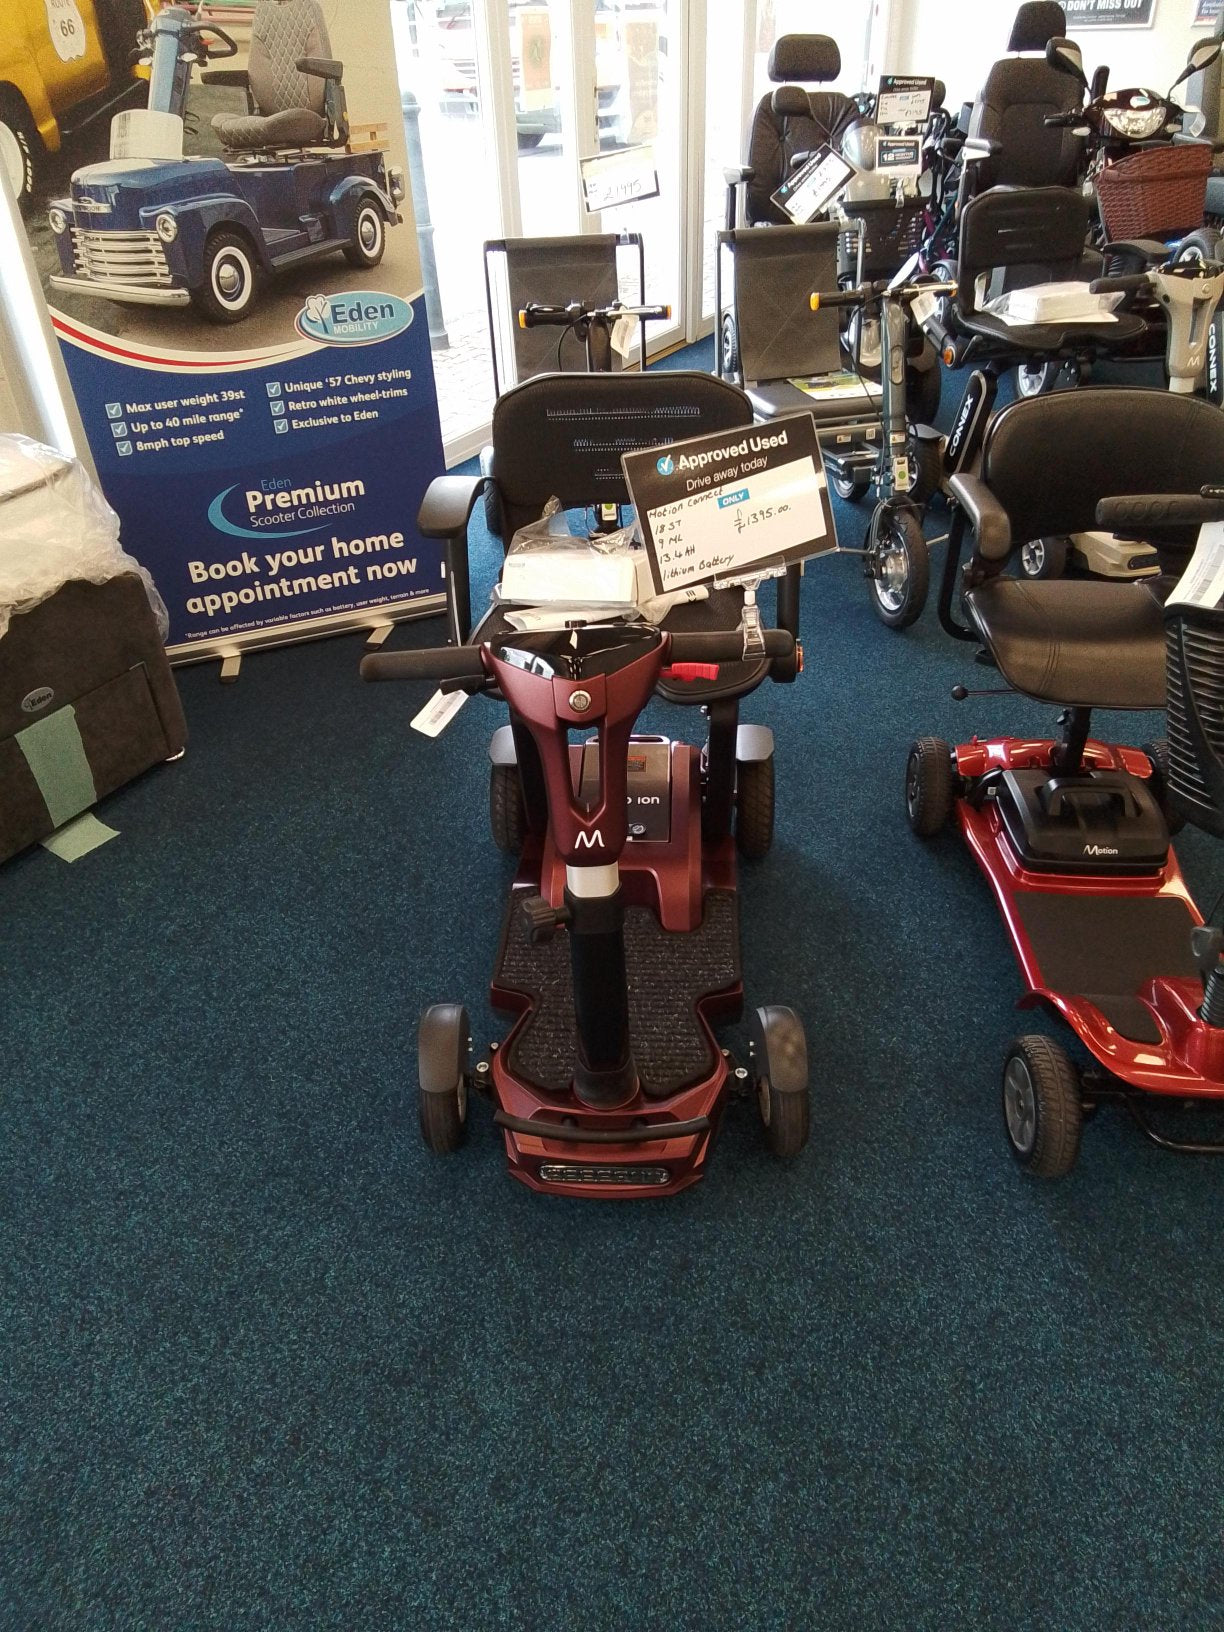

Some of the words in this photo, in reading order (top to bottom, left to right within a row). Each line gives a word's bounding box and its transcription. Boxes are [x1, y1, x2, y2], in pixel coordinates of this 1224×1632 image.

[61, 18, 75, 37] 66
[330, 301, 395, 325] Eden
[285, 379, 323, 393] Unique
[344, 373, 375, 386] Chevy
[377, 369, 412, 382] styling
[126, 402, 152, 414] Max
[154, 400, 178, 410] user
[180, 393, 219, 407] weight
[220, 389, 246, 401] 39st
[288, 399, 317, 411] Retro
[319, 394, 348, 407] white
[350, 387, 408, 403] wheel-trims
[131, 422, 149, 434] Up
[151, 420, 163, 430] to
[165, 417, 180, 428] 40
[182, 414, 206, 426] mile
[292, 415, 339, 429] Exclusive
[340, 412, 352, 423] to
[353, 410, 379, 422] Eden
[949, 393, 974, 457] CONNEX
[136, 438, 169, 452] 8mph
[171, 435, 191, 447] top
[192, 430, 225, 445] speed
[678, 440, 749, 470] Approved
[749, 430, 788, 452] Used
[261, 477, 292, 491] Eden
[686, 475, 711, 492] Drive
[713, 465, 739, 482] away
[741, 455, 768, 473] today
[245, 479, 366, 513] Premium
[722, 491, 745, 506] ONLY
[250, 511, 296, 528] Scooter
[297, 502, 355, 520] Collection
[648, 503, 683, 518] Motion
[655, 524, 665, 535] 18
[658, 538, 664, 549] 9
[187, 552, 260, 584] Book
[265, 544, 326, 576] your
[331, 531, 405, 559] home
[699, 554, 735, 570] Battery
[186, 567, 361, 617] appointment
[366, 558, 418, 581] now
[208, 627, 220, 635] can
[220, 625, 229, 633] be
[256, 619, 264, 627] by
[265, 614, 288, 624] variable
[289, 610, 310, 619] factors
[310, 606, 324, 615] such
[415, 588, 430, 596] more
[31, 693, 52, 706] Eden
[1082, 844, 1118, 856] Motion
